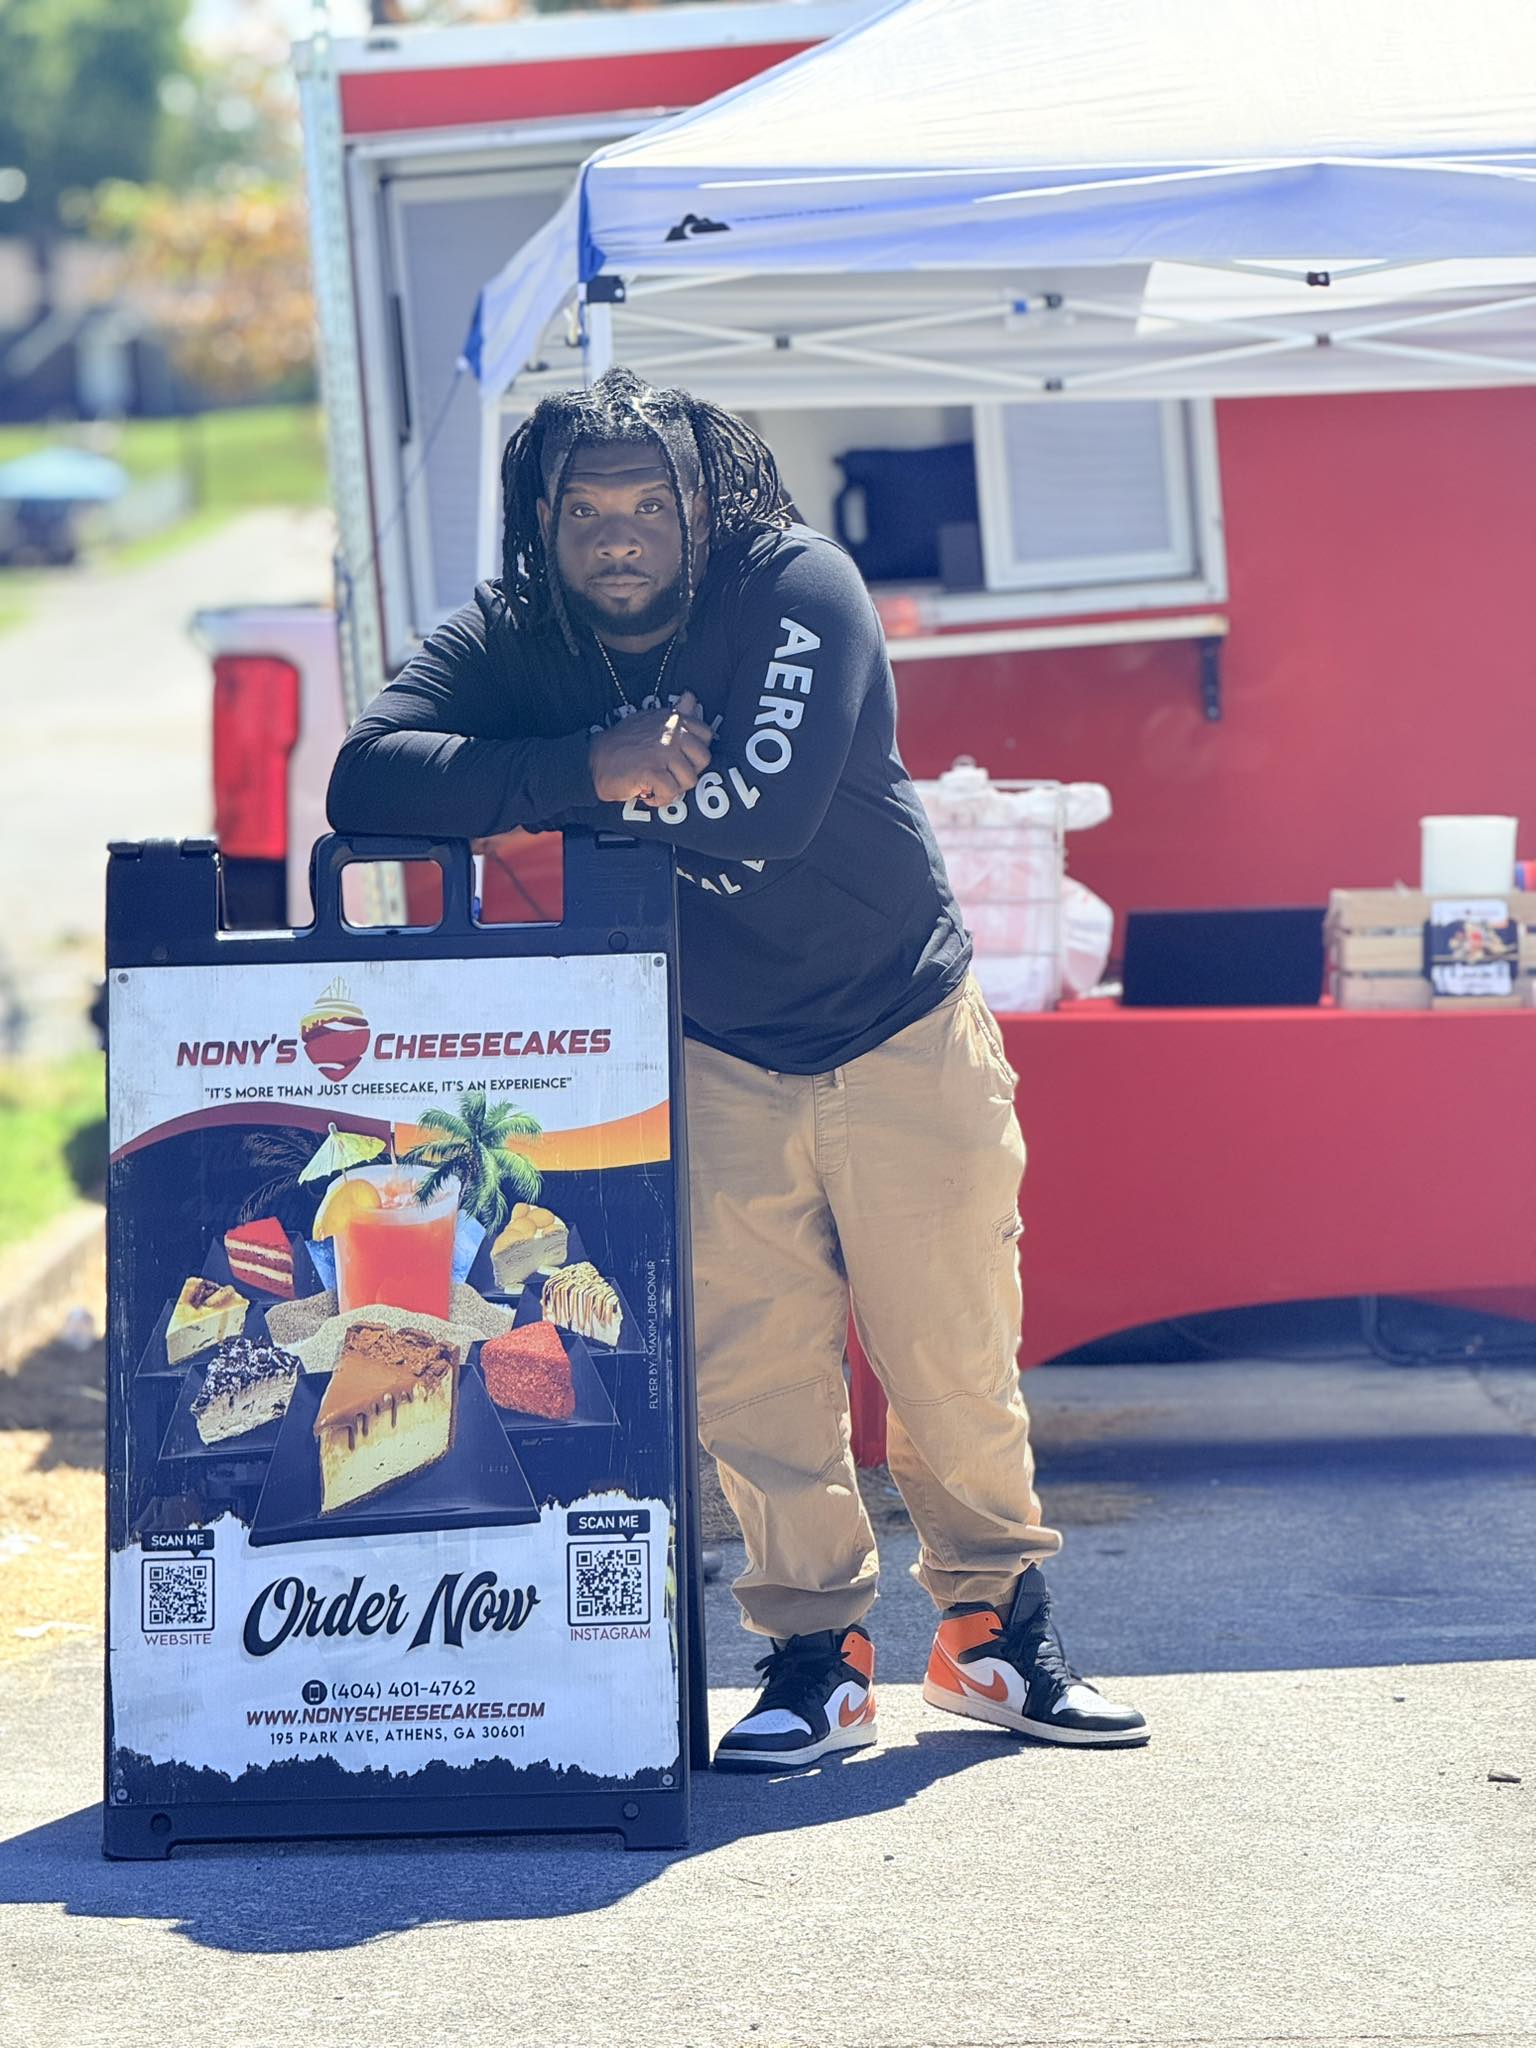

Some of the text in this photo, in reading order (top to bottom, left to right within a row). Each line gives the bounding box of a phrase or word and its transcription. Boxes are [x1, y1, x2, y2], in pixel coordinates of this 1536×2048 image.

[745, 617, 821, 774] AERO
[177, 1029, 611, 1066] NONY'S CHEESECAKES
[205, 1077, 572, 1099] "IT'S MORE THAN JUST CHEESECAKE, IT'S AN EXPERIENCE"
[650, 1377, 659, 1409] FLYER
[578, 1515, 639, 1530] SCAN ME
[151, 1533, 205, 1547] SCAN ME
[243, 1571, 541, 1657] Order Now
[144, 1632, 212, 1646] WEBSITE
[570, 1626, 652, 1642] INSTAGRAM
[331, 1679, 477, 1700] (404) 401-4762
[246, 1702, 545, 1726] WWW.NONYSCHEESECAKES.COM
[270, 1725, 525, 1745] 195 PARK AVE, ATHENS, GA 30601
